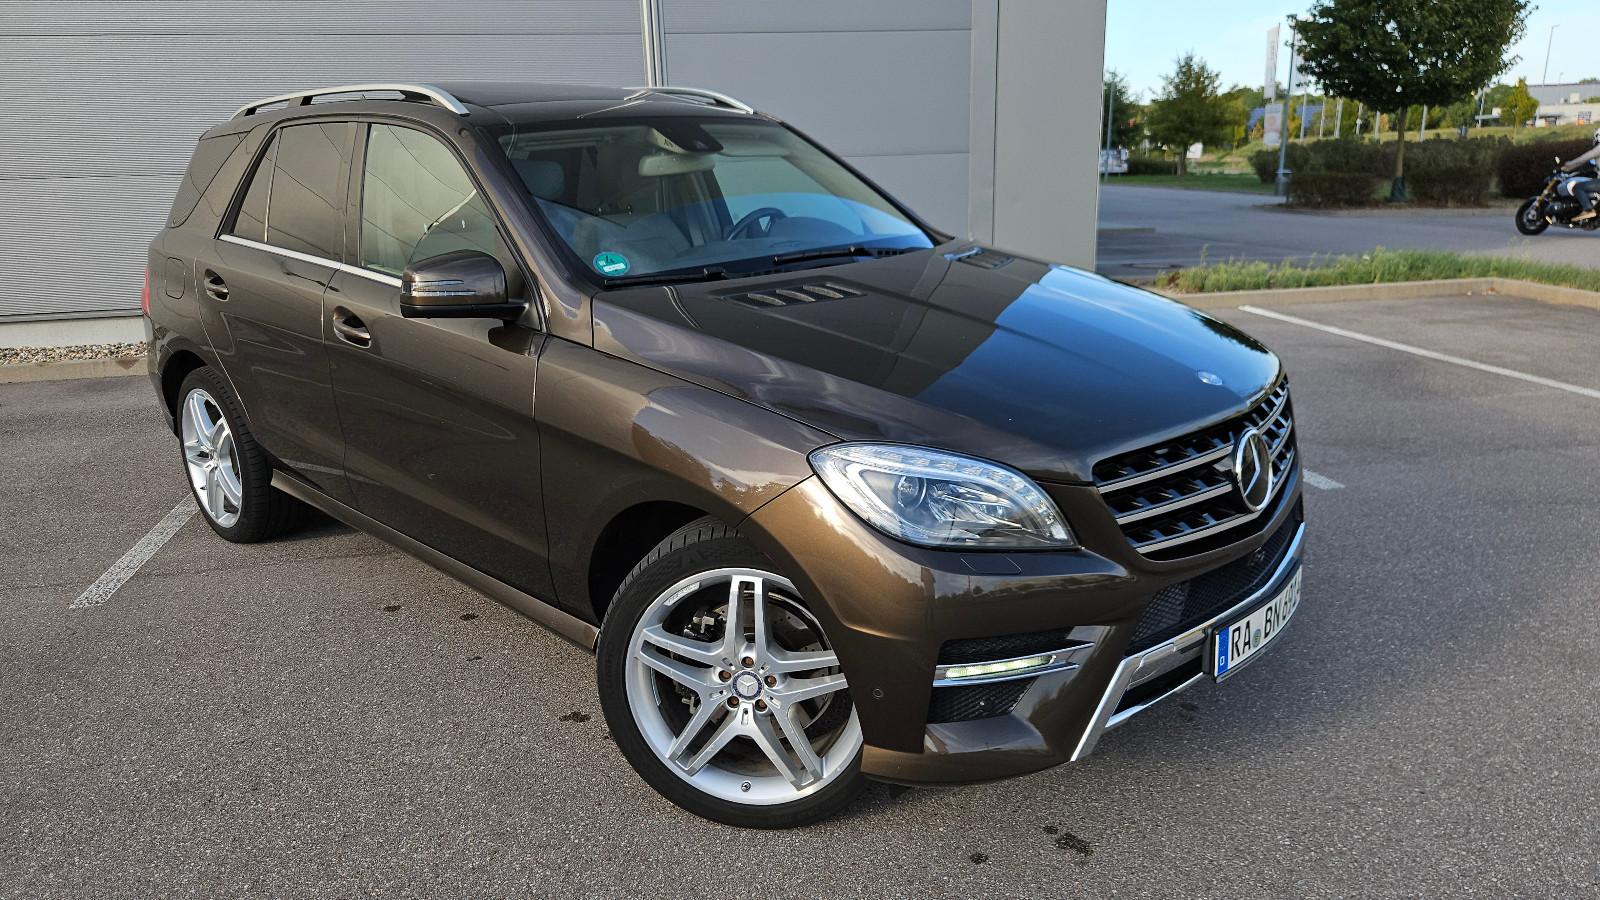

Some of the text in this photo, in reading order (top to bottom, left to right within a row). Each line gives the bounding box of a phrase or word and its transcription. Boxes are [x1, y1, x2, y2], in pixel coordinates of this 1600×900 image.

[1219, 655, 1225, 666] D
[1230, 620, 1251, 662] RA
[1263, 600, 1281, 639] BN
